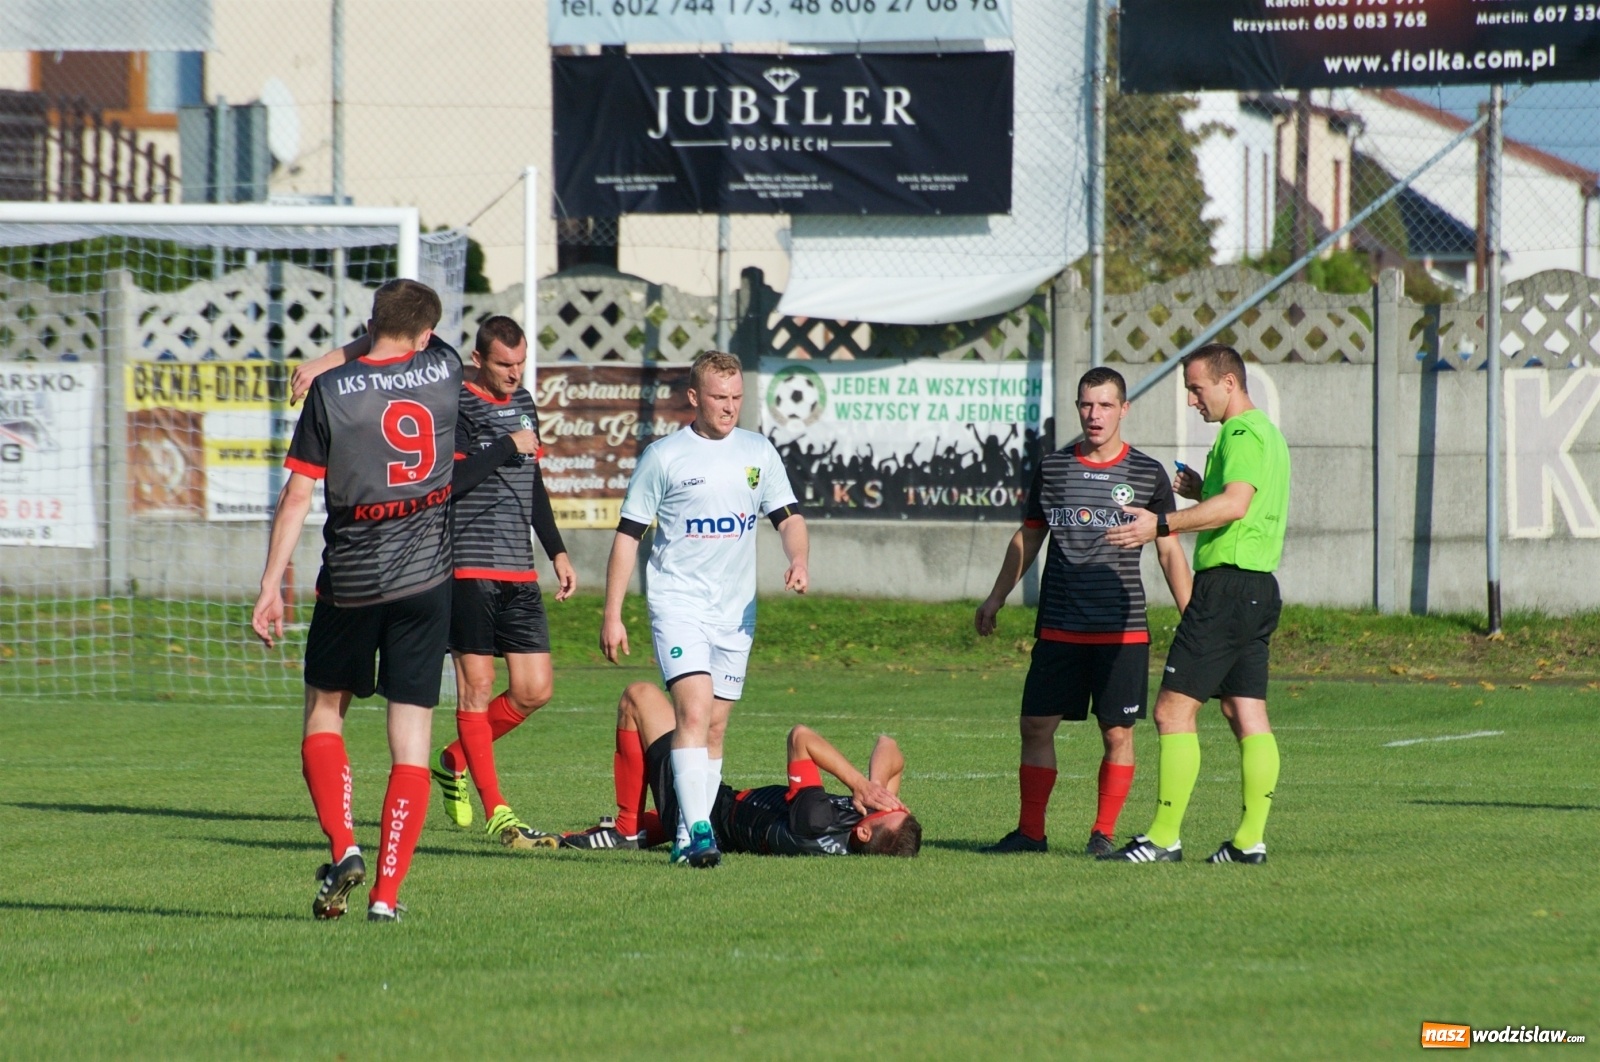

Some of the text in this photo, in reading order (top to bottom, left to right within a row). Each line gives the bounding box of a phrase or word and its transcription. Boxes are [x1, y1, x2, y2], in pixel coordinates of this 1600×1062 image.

[612, 0, 659, 16] 602
[1476, 10, 1528, 25] Marcin:
[1533, 5, 1567, 23] 607
[1233, 11, 1427, 33] Krzysztof: 605 083 762
[1324, 44, 1556, 73] www.fiolka.com.pl
[731, 135, 829, 151] POŚPIECH
[337, 360, 450, 395] LKS TWORKÓW
[832, 377, 1043, 397] JEDEN ZA WSZYSTKICH
[536, 373, 672, 407] Restauracja
[835, 402, 1041, 423] WSZYSCY ZA JEDNEGO
[381, 399, 437, 488] 9
[686, 511, 757, 541] moya
